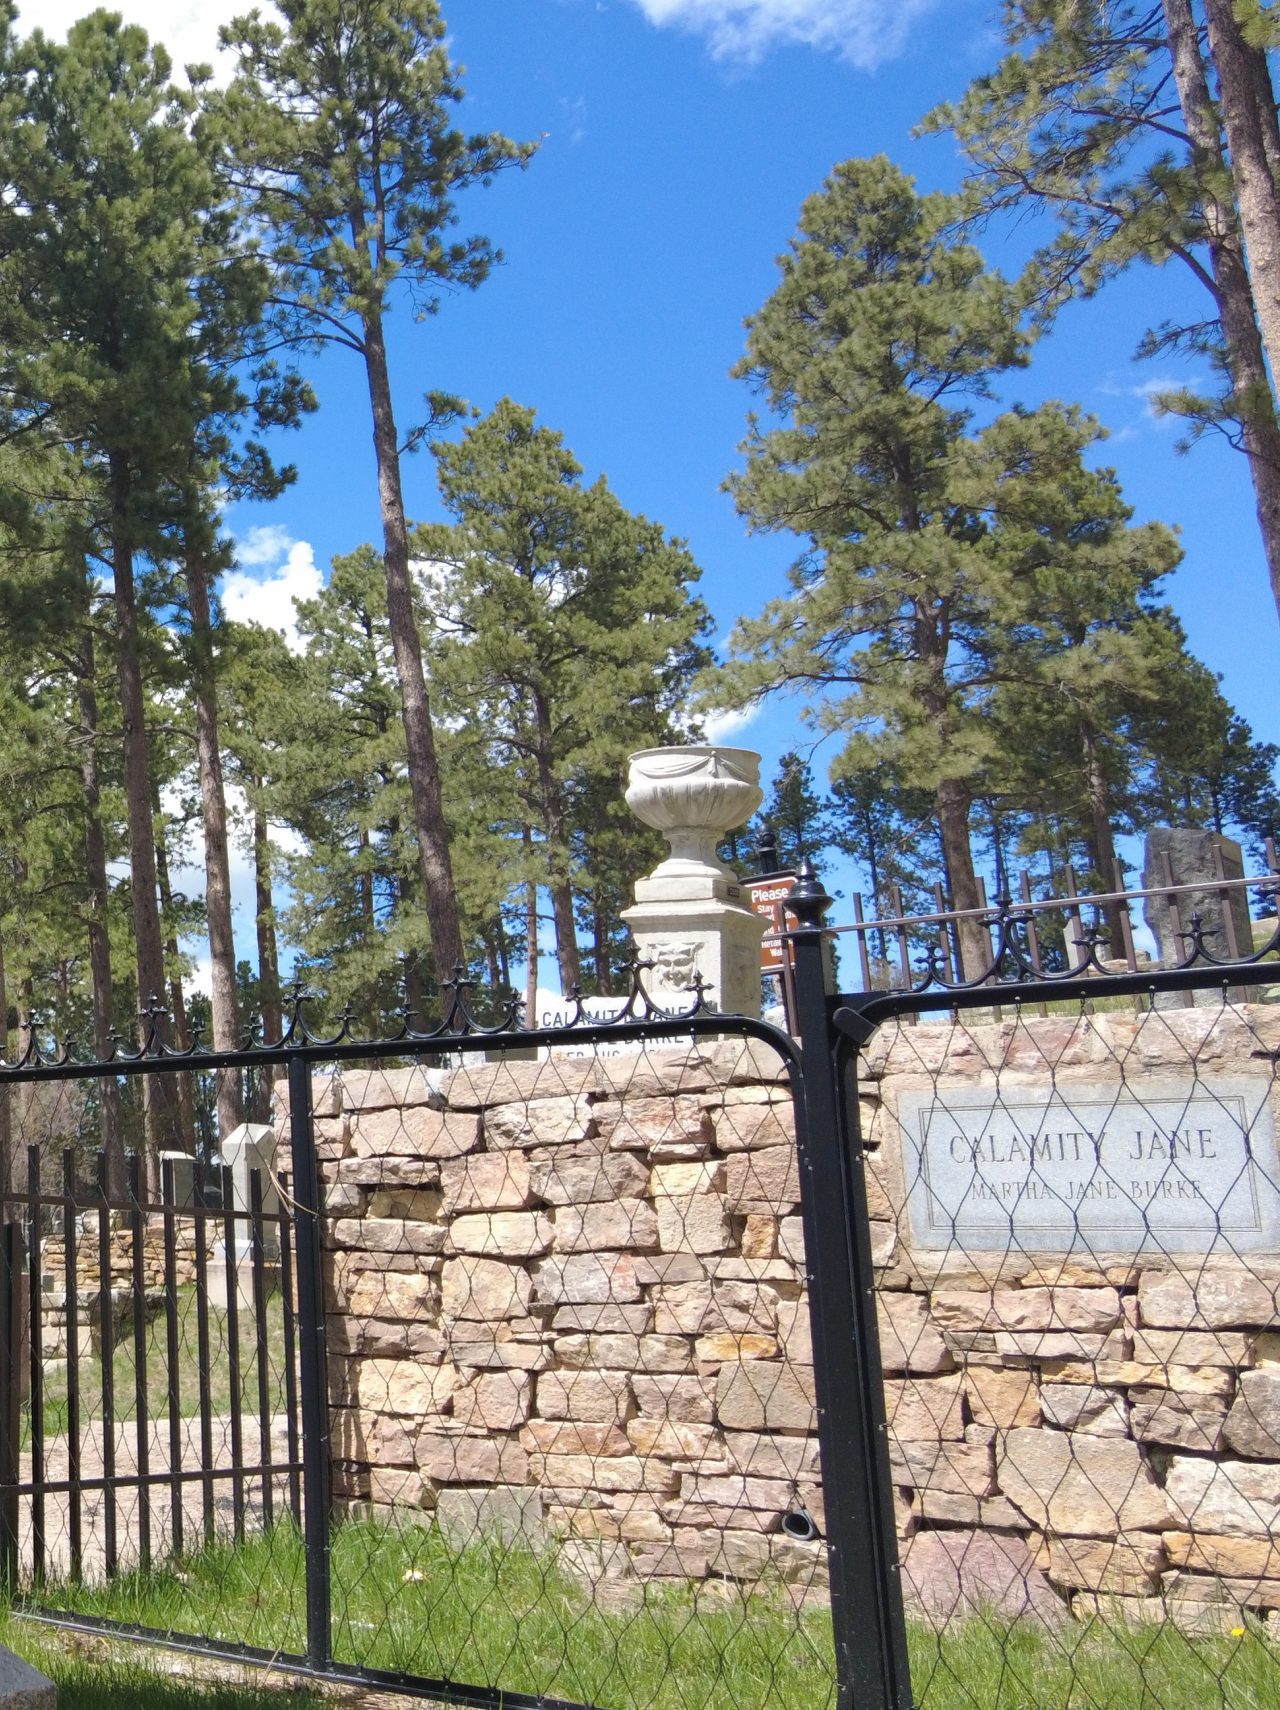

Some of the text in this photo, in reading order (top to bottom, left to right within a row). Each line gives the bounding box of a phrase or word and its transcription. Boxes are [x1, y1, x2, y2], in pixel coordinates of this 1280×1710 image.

[751, 887, 789, 904] Please
[757, 904, 775, 914] Stay
[542, 1008, 631, 1028] CALAMIT
[949, 1127, 1218, 1164] CALAMITY JANE
[971, 1179, 1203, 1201] MARTHA JANE BURKE
